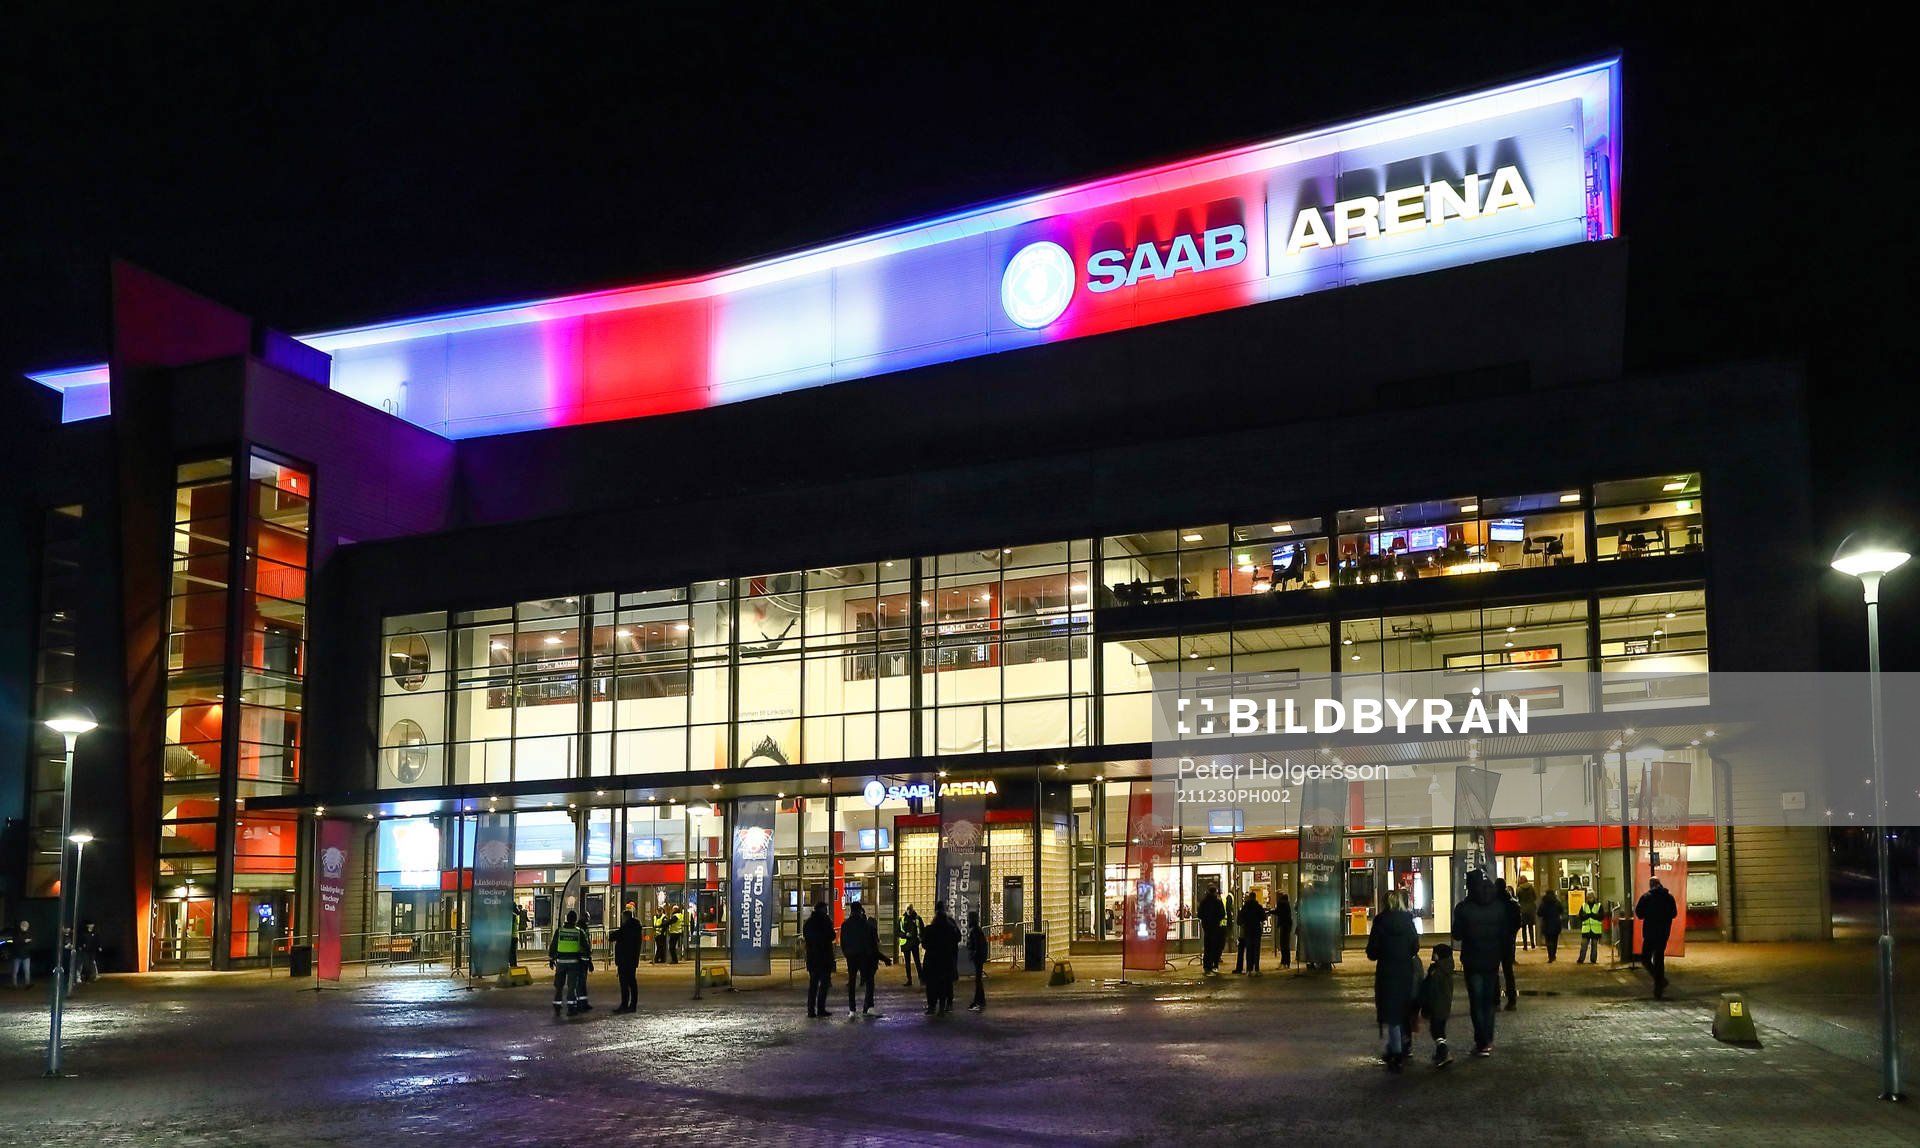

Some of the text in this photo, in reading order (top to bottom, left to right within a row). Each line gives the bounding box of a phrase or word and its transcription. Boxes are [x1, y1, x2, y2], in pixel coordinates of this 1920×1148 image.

[1086, 165, 1536, 293] SAAB ARENA
[888, 780, 997, 800] SAAB ARENA
[960, 860, 971, 892] Club
[1305, 863, 1335, 872] Hockey
[475, 880, 512, 888] Linköping
[322, 894, 339, 903] Hockey
[324, 903, 336, 911] Club
[741, 873, 753, 940] Linköping
[753, 865, 763, 948] Hockey Club
